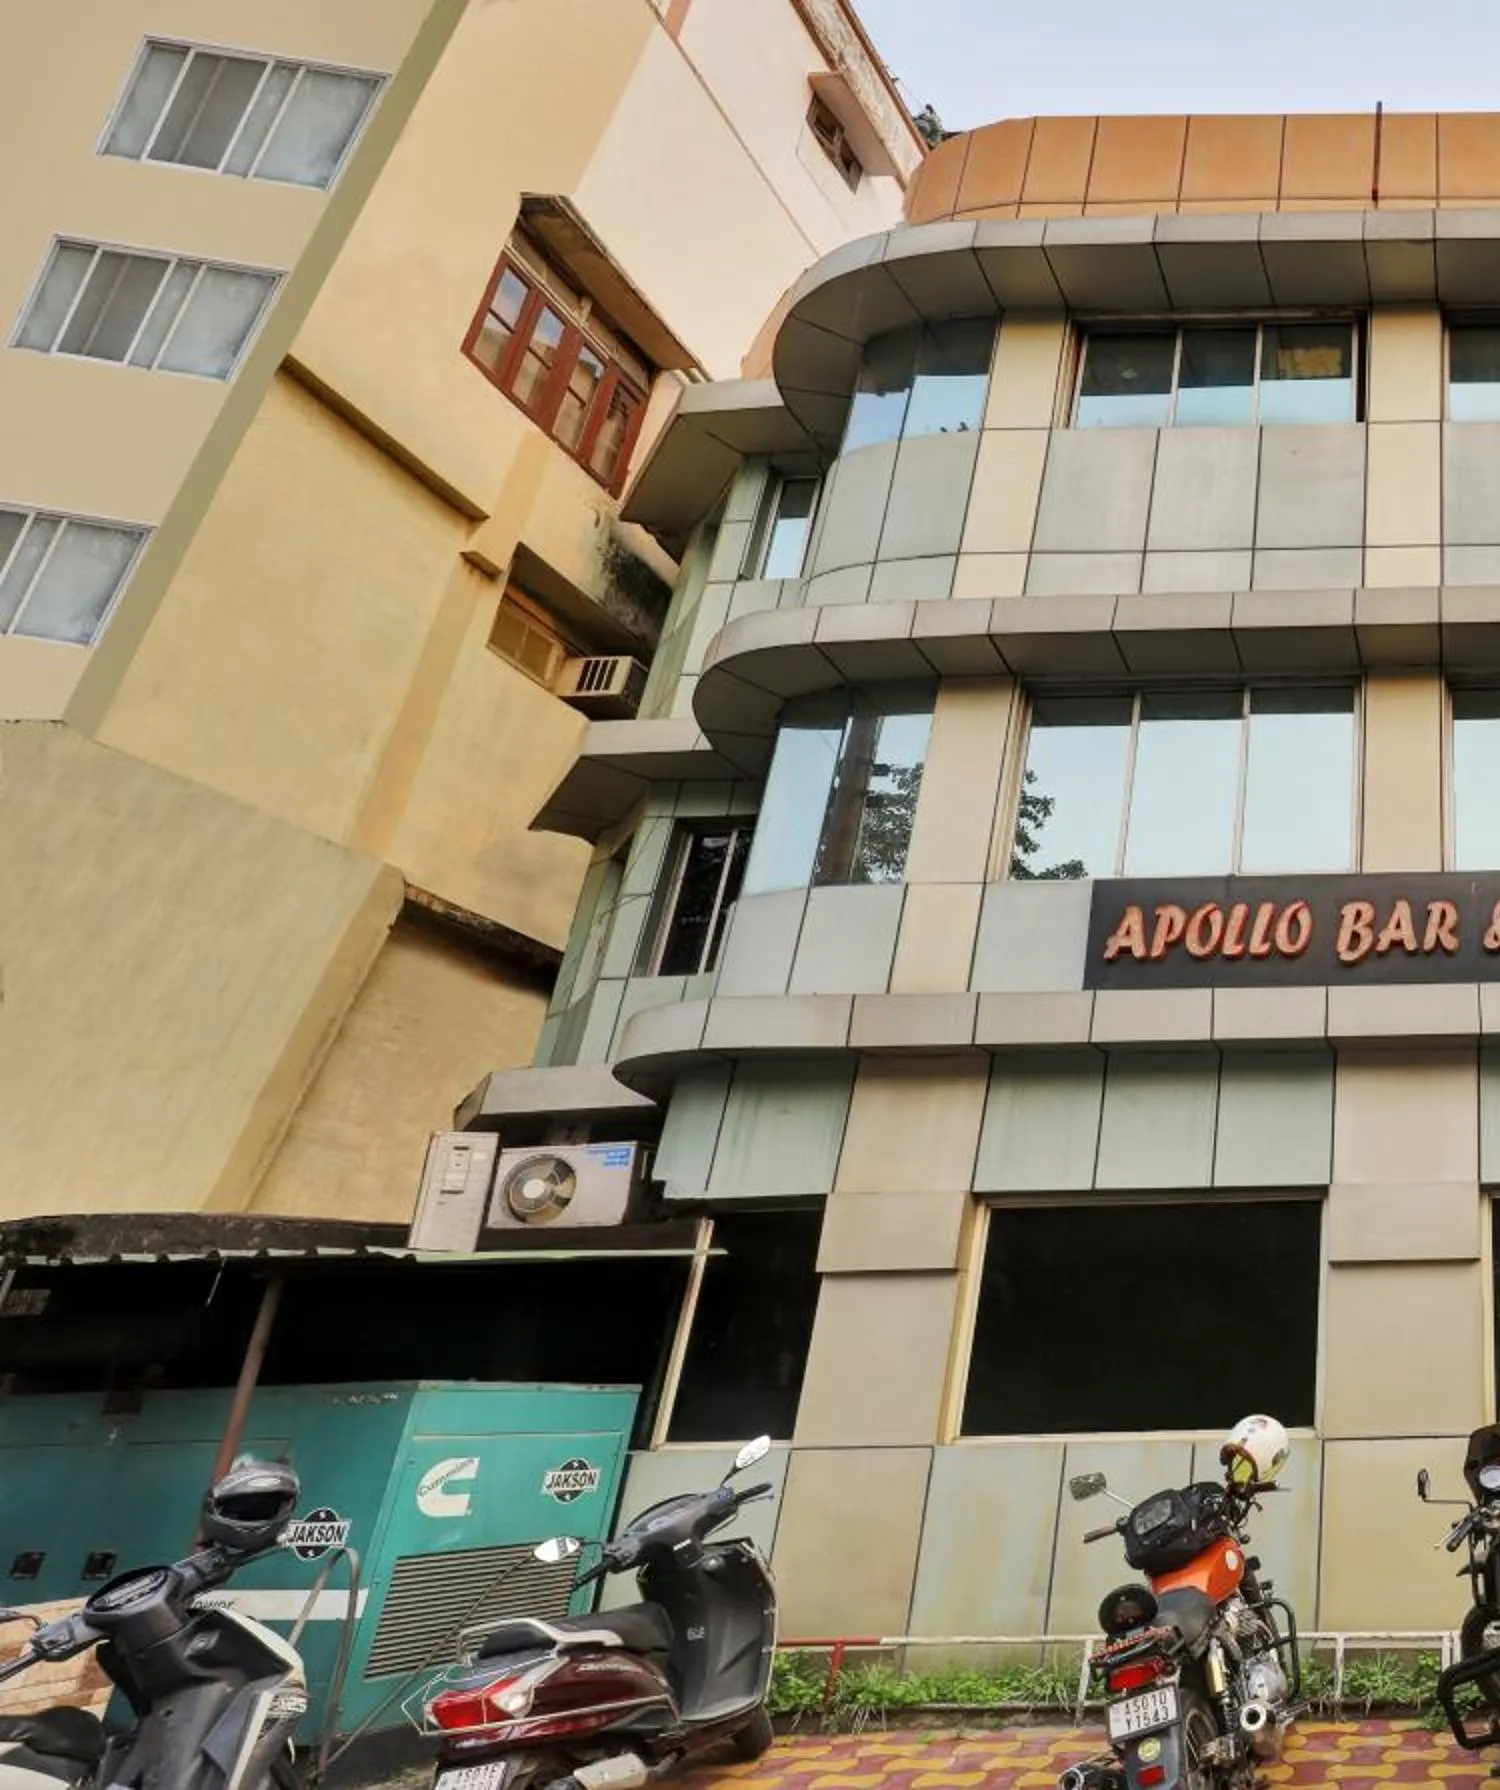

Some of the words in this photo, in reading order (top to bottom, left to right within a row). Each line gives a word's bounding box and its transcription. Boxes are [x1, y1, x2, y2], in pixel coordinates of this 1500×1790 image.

[1102, 899, 1315, 962] APOLLO
[1333, 897, 1461, 968] BAR
[546, 1471, 598, 1490] JAKSON
[287, 1524, 348, 1543] JAKSON
